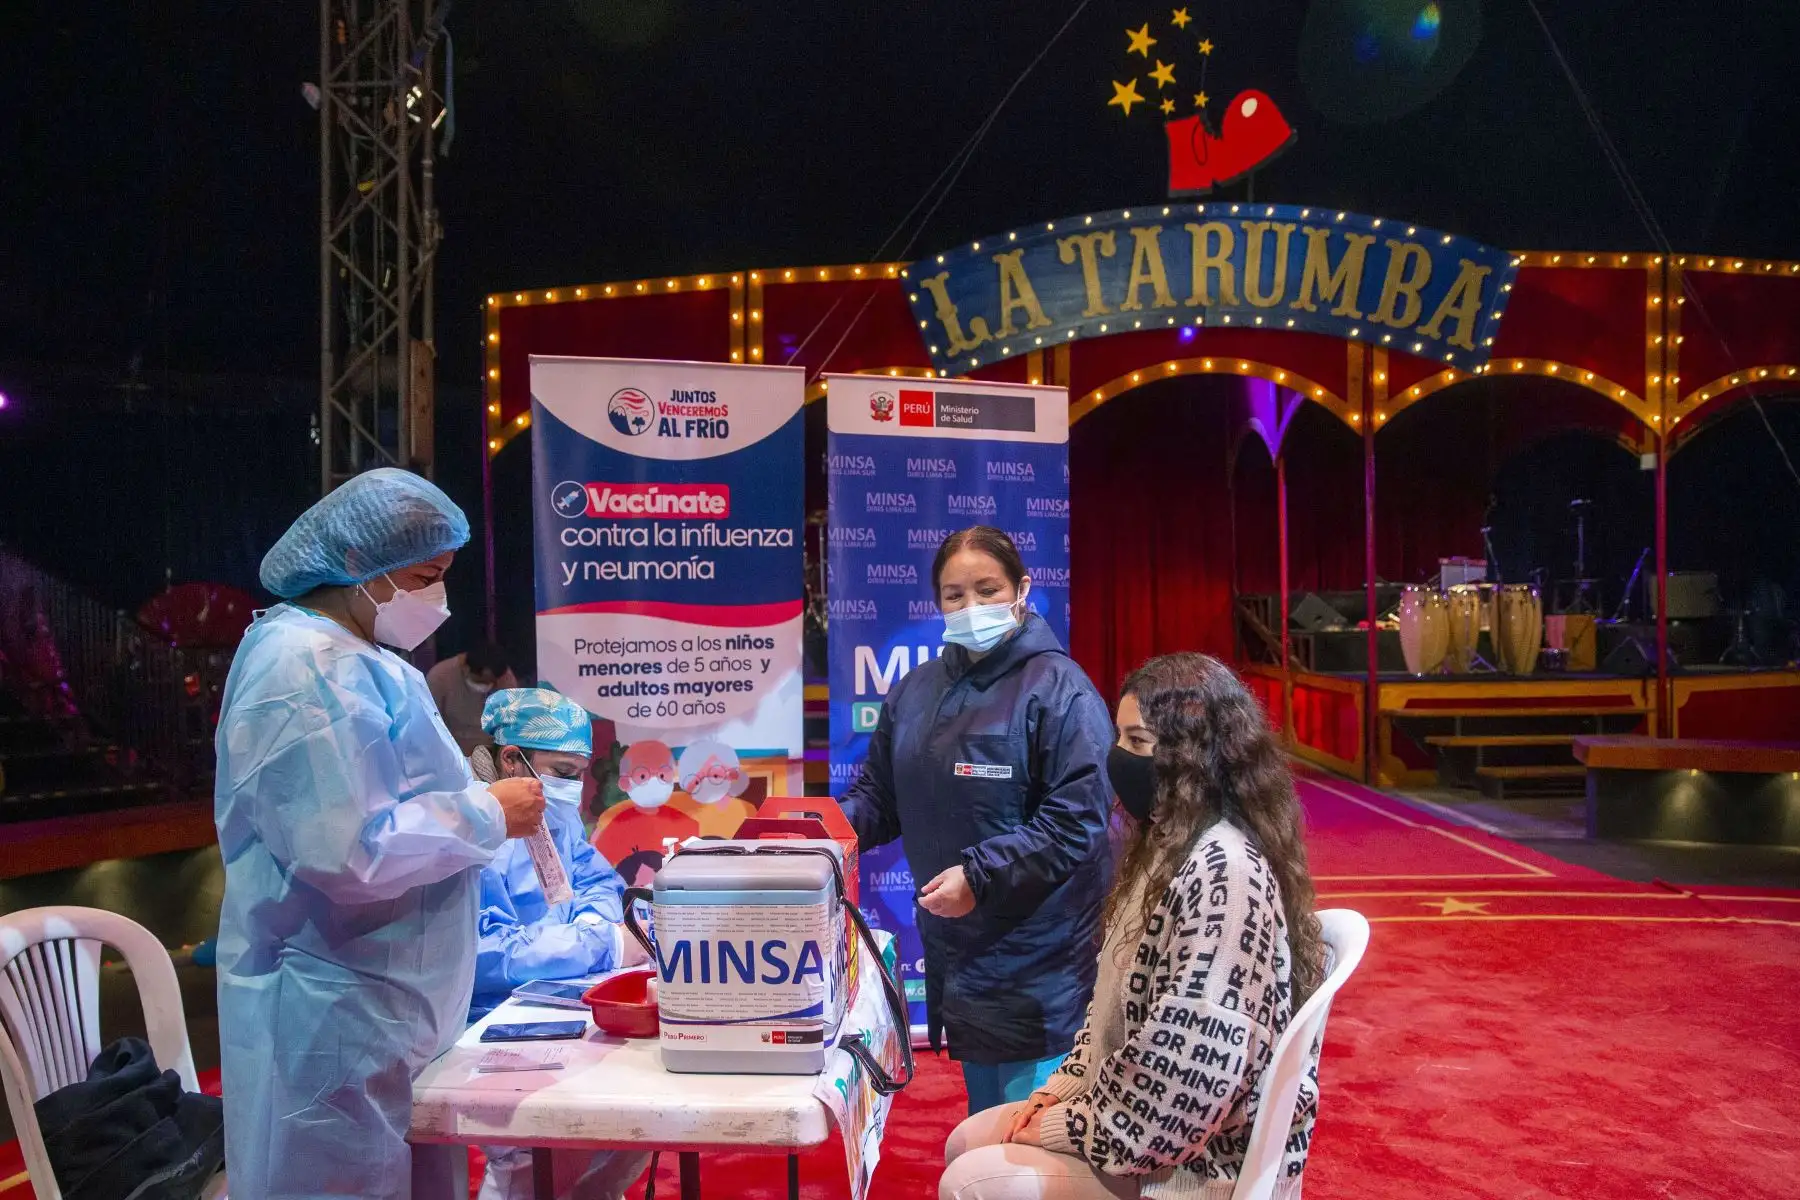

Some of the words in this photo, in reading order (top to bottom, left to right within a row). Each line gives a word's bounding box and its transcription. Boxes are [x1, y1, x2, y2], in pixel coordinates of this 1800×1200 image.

[920, 249, 1052, 357] LA
[1059, 221, 1492, 352] TARUMBA
[670, 389, 716, 403] JUNTOS
[903, 402, 930, 414] PERÚ
[940, 405, 980, 415] Ministerio
[940, 414, 951, 422] de
[952, 415, 973, 424] Salud
[658, 417, 681, 437] AL
[685, 417, 729, 439] FRÍO
[828, 455, 876, 469] MINSA
[907, 457, 956, 472] MINSA
[986, 461, 1035, 476] MINSA
[587, 486, 727, 514] Vacúnate
[866, 492, 916, 507] MINSA
[948, 494, 997, 509] MINSA
[560, 524, 649, 548] contra
[654, 522, 676, 547] la
[681, 522, 793, 548] influenza
[828, 527, 876, 541] MINSA
[908, 529, 950, 543] MINS
[1007, 531, 1036, 545] NSA
[561, 560, 578, 586] y
[584, 555, 715, 580] neumonía
[867, 563, 917, 578] MINSA
[828, 599, 877, 614] MINSA
[908, 600, 939, 614] MIN
[574, 638, 677, 659] Protejamos
[681, 640, 693, 653] a
[697, 635, 722, 651] los
[725, 634, 775, 650] niños
[578, 660, 662, 677] menores
[667, 658, 690, 674] de
[694, 657, 704, 673] 5
[709, 656, 752, 672] años
[761, 657, 771, 674] y
[597, 680, 669, 697] adultos
[673, 678, 753, 698] mayores
[627, 702, 651, 718] de
[656, 700, 678, 717] 60
[682, 698, 726, 716] años
[829, 763, 864, 777] MINS
[656, 939, 824, 985] MINSA
[1155, 1005, 1246, 1047] EAMING
[1151, 1029, 1186, 1056] OR
[1190, 1043, 1231, 1072] AM
[1120, 1043, 1231, 1099] REAMING
[1132, 1072, 1168, 1102] OR
[1170, 1092, 1213, 1121] AM
[1100, 1067, 1207, 1145] DREAMING
[1110, 1110, 1146, 1144] OR
